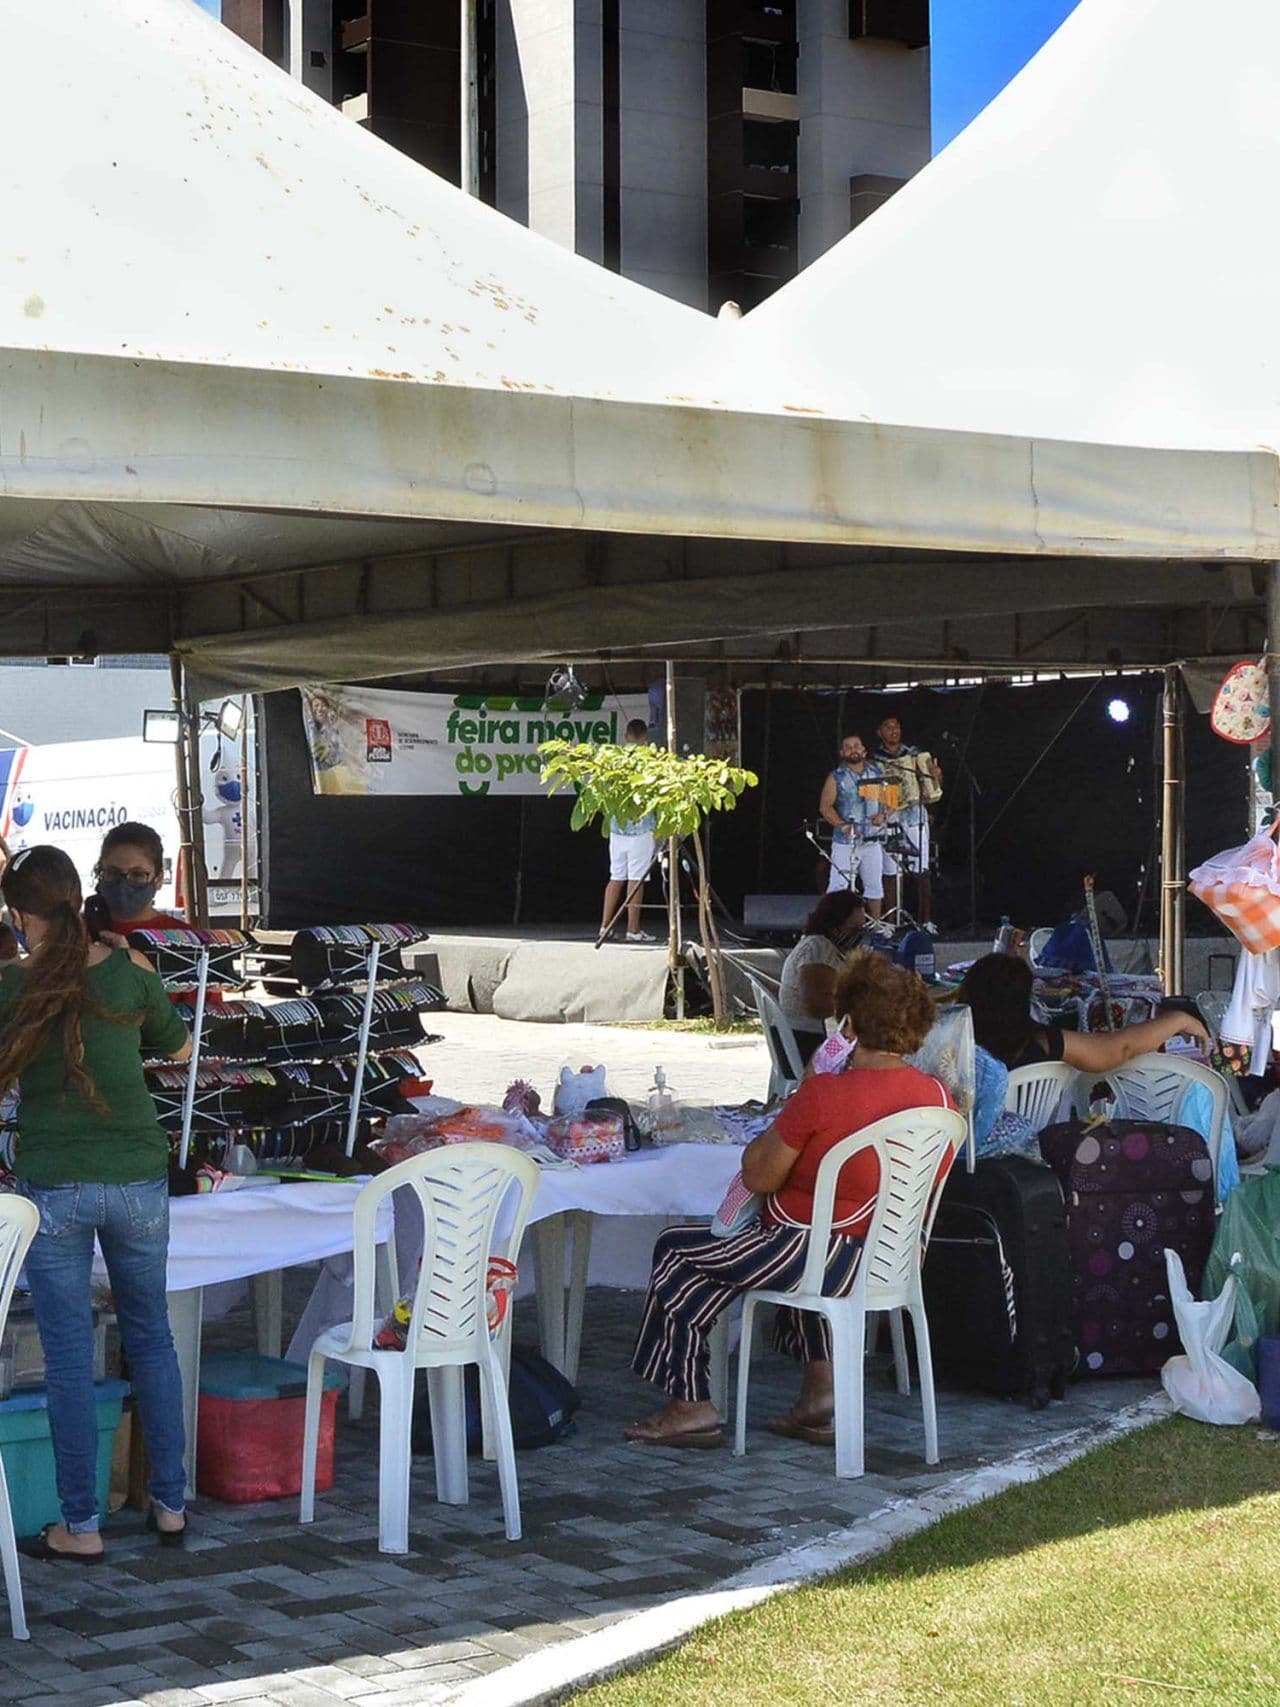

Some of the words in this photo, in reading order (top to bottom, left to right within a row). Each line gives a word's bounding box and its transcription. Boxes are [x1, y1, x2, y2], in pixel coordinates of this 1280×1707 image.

[447, 710, 520, 744] feira
[527, 711, 618, 745] móvel
[455, 746, 492, 774] do
